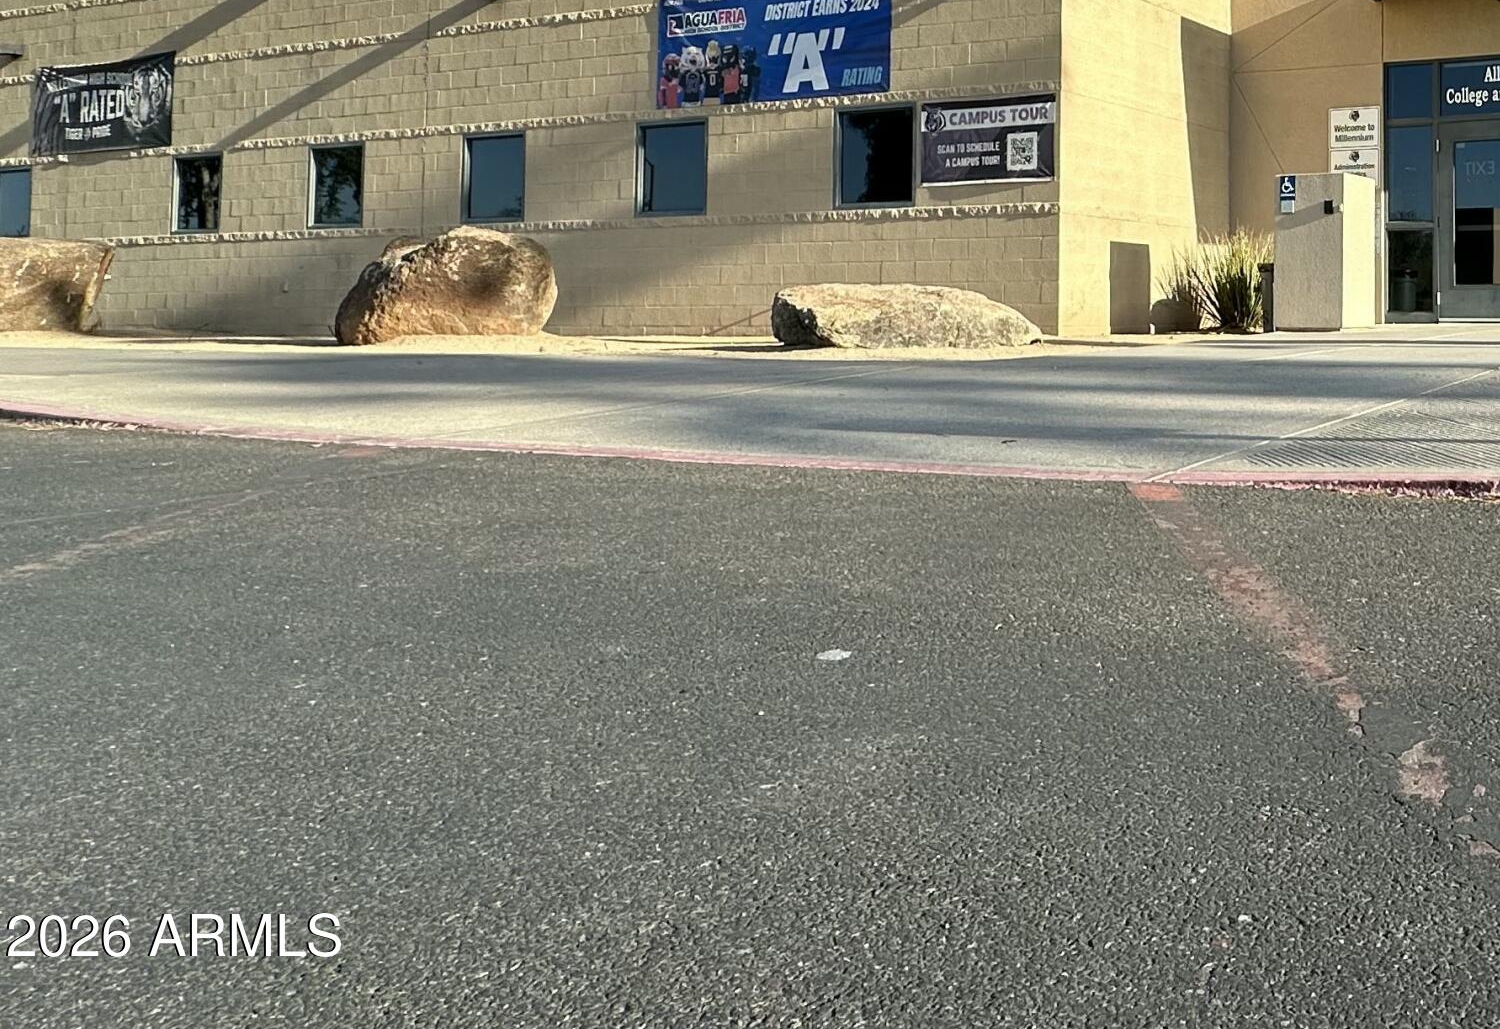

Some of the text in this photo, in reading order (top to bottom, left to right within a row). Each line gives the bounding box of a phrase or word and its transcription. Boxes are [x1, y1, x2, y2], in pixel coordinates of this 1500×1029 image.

[764, 0, 811, 21] DISTRICT
[841, 66, 882, 88] RATING
[1484, 64, 1500, 83] All
[80, 88, 125, 124] RATED
[1446, 87, 1489, 107] College
[950, 106, 1048, 126] CAMPUS TOUR
[1334, 123, 1375, 133] Welcome to
[937, 141, 1000, 154] SCAN TO SCHEDULE
[1335, 134, 1374, 142] Millennium
[945, 159, 950, 168] A
[952, 157, 980, 167] CAMPUS
